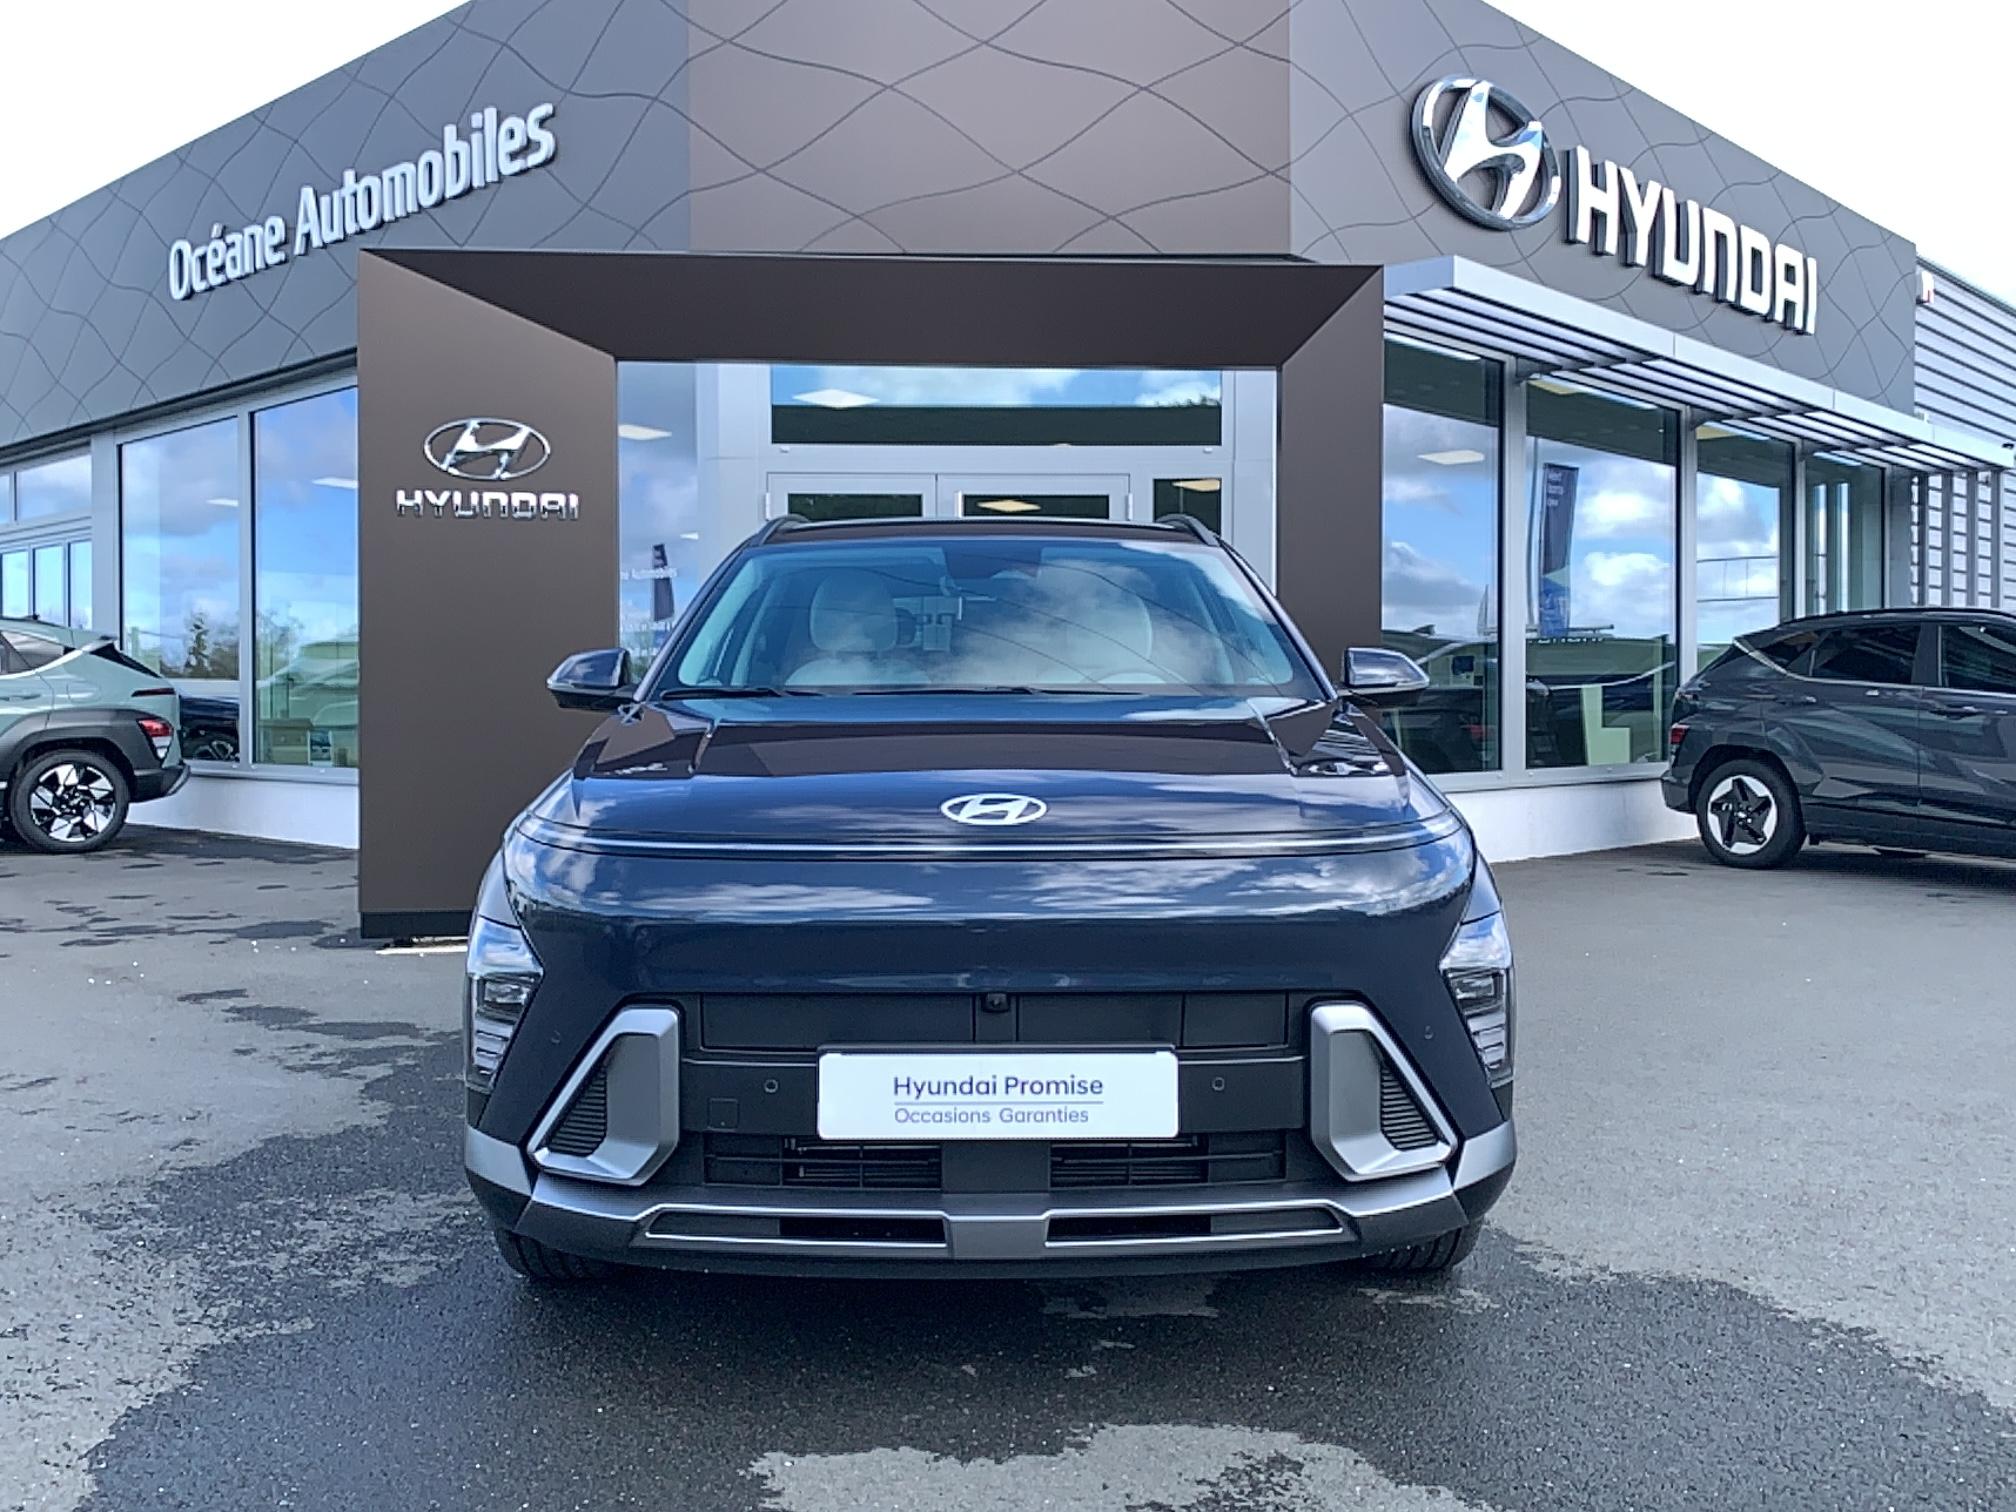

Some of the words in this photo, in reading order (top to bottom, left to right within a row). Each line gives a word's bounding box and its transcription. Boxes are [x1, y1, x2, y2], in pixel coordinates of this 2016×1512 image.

[168, 215, 286, 301] Océane
[293, 102, 557, 256] Automobiles
[1567, 144, 1818, 335] HYUNDAI
[396, 489, 580, 521] HYUNDAI
[893, 1074, 998, 1100] Hyundai
[1004, 1074, 1104, 1096] Promise
[894, 1106, 992, 1124] Occasions
[999, 1106, 1089, 1124] Garanties
